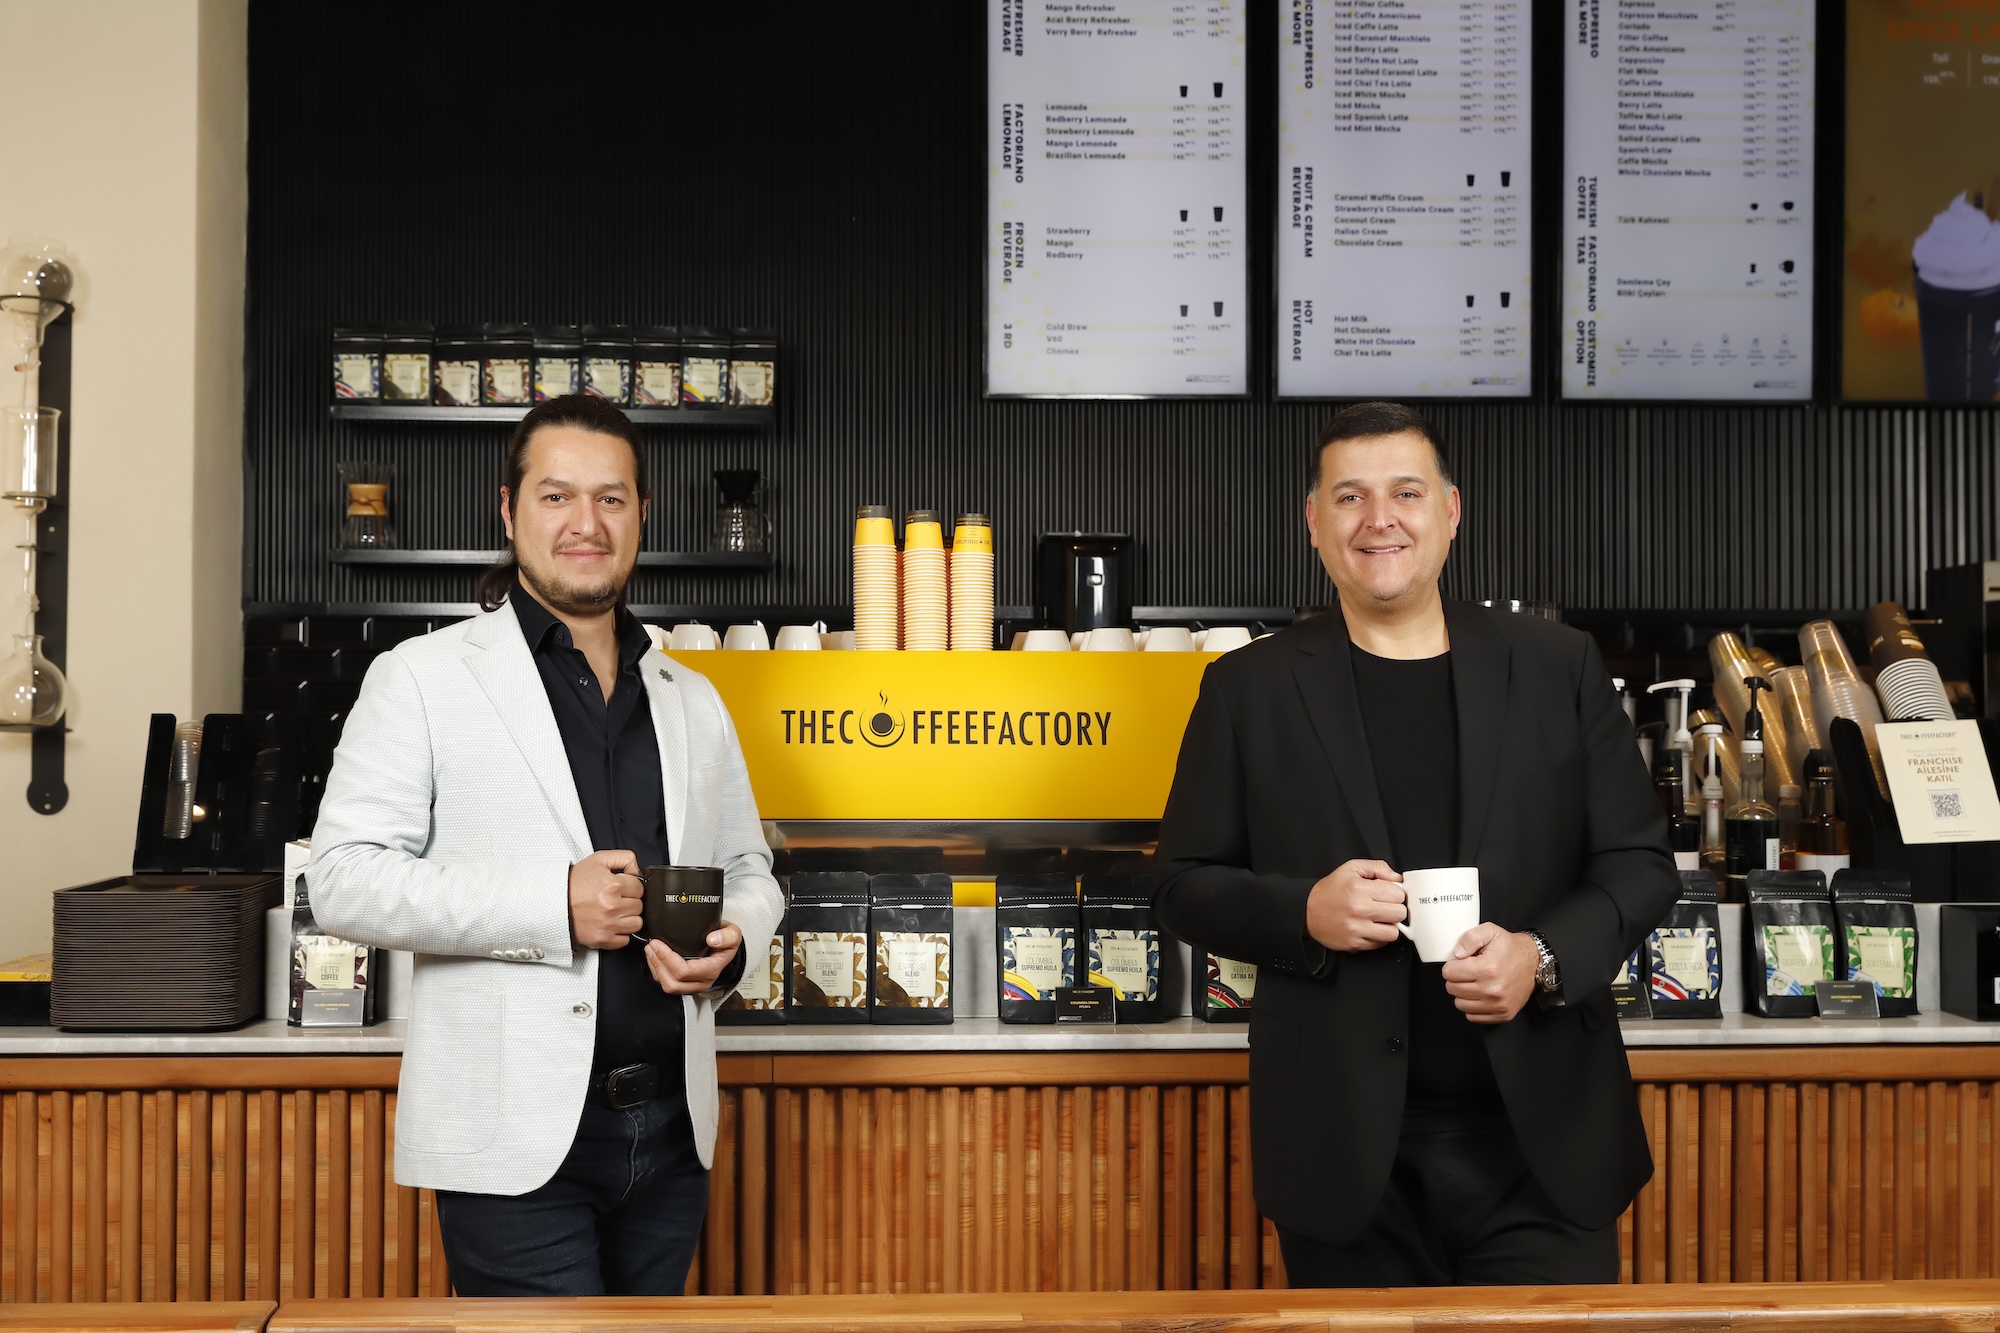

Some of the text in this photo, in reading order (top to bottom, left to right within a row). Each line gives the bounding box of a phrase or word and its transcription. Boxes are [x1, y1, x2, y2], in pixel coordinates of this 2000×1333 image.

[1046, 4, 1115, 12] Mango Refresher
[1066, 16, 1087, 24] Berry
[1091, 16, 1130, 24] Refresher
[1579, 12, 1587, 43] MORE
[1591, 0, 1599, 58] ESPRESSO
[1070, 28, 1092, 37] Berry
[1305, 0, 1313, 88] ICED ESPRESSO
[1046, 116, 1082, 124] Redberry
[1003, 104, 1011, 168] LEMONADE
[1046, 128, 1134, 136] Strawberry Lemonade
[1046, 140, 1117, 148] Mango Lemonade
[1084, 152, 1125, 160] Lemonade
[1293, 167, 1301, 227] BEVERAGE
[1589, 178, 1597, 227] TURKISH
[1047, 227, 1090, 236] Strawberry
[1046, 240, 1073, 248] Mango
[1046, 251, 1083, 260] Redberry
[1047, 323, 1087, 331] Cold Brew
[1293, 301, 1301, 360] BEVERAGE
[1047, 347, 1079, 355] Chemex
[1908, 757, 1964, 766] FRANCHISE
[1927, 775, 1954, 783] KATIL
[816, 962, 843, 970] ESPRESSO
[899, 963, 926, 971] ESPRESSO
[1232, 965, 1251, 973] KENYA
[1669, 963, 1688, 971] COSTA
